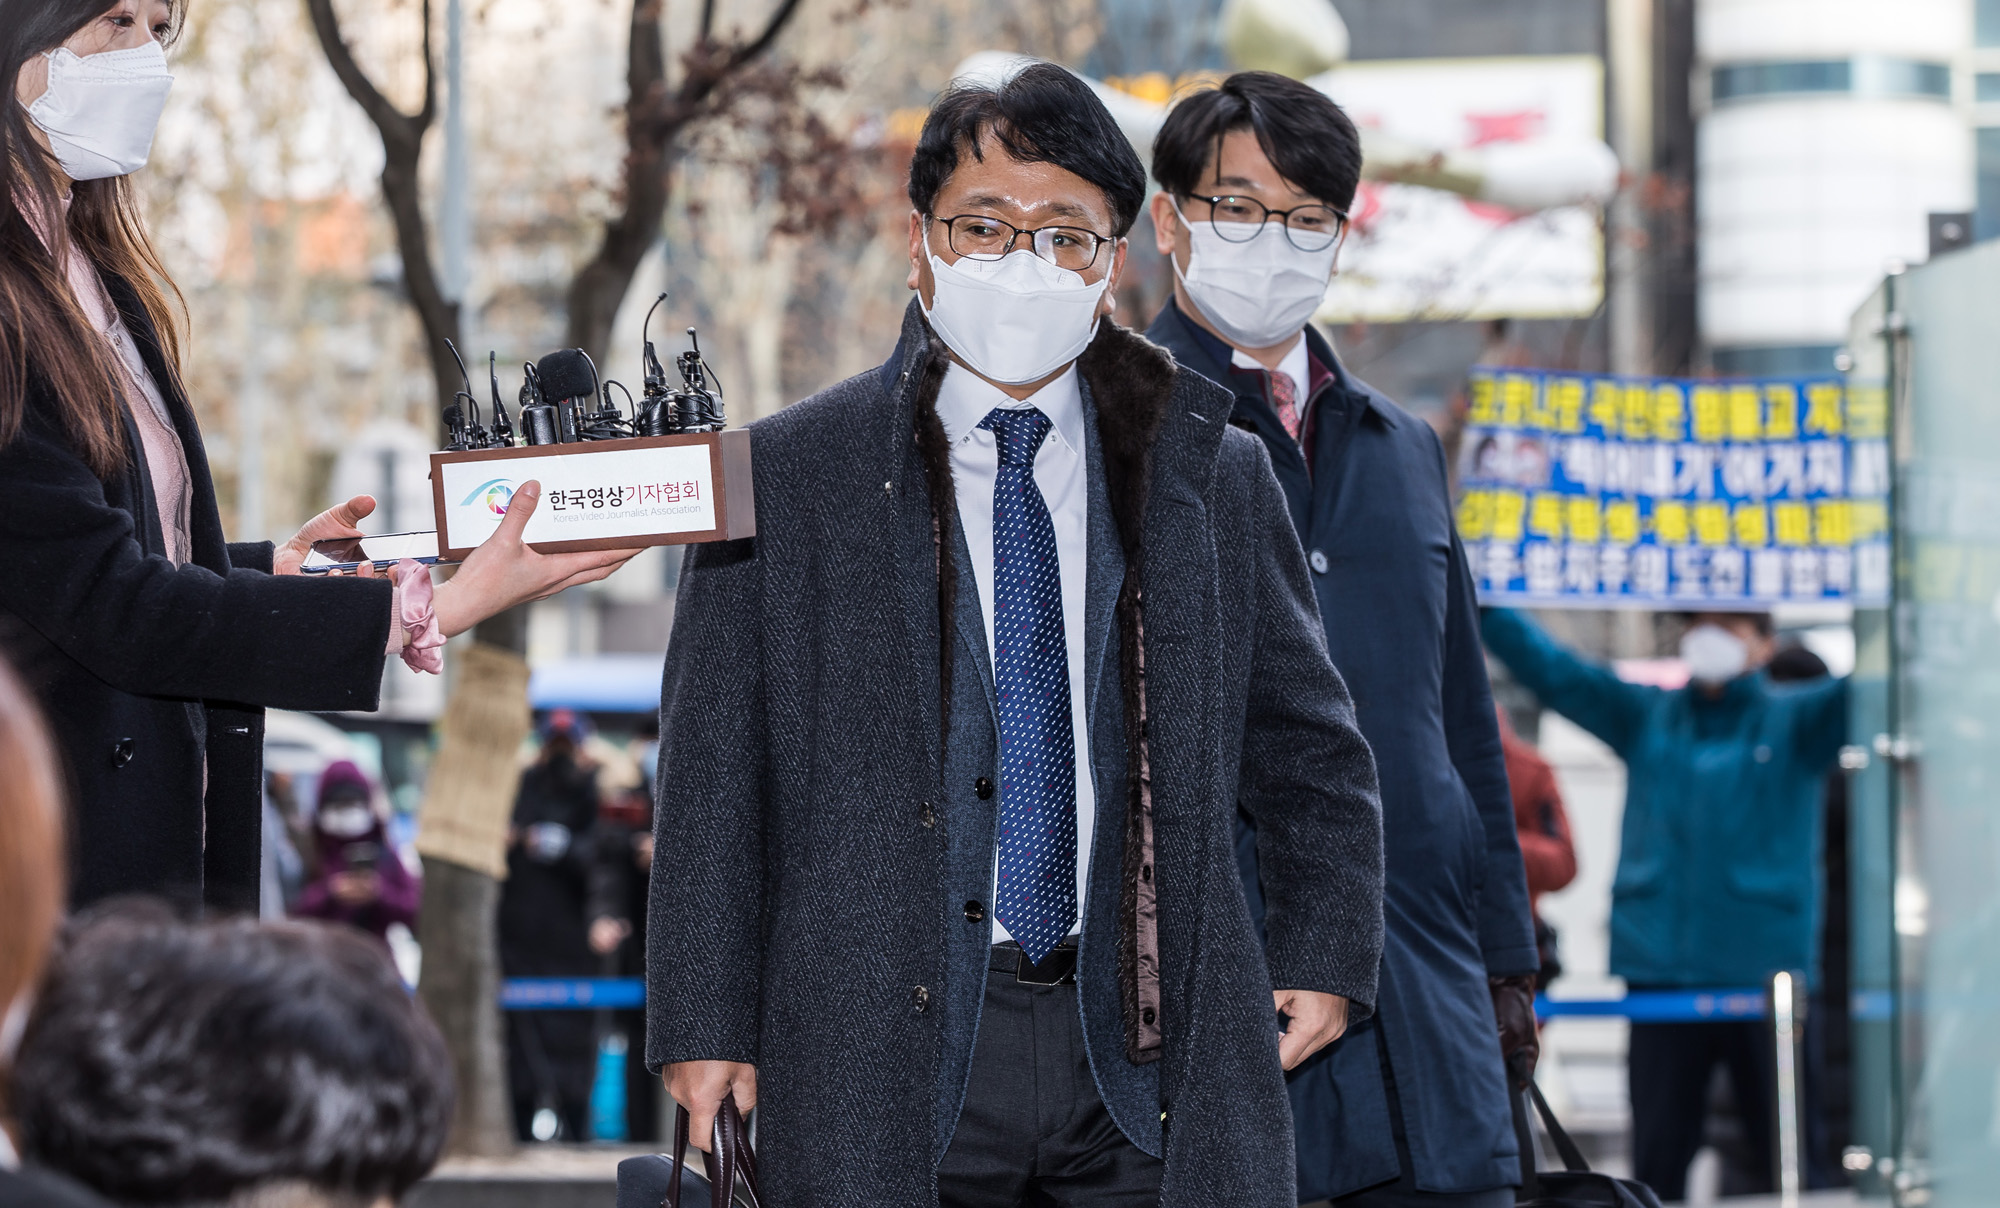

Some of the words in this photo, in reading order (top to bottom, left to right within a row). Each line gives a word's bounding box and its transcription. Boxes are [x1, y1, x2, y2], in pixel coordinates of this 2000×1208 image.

[549, 480, 700, 511] 한국영상기자협회
[553, 514, 579, 523] Korea
[580, 511, 605, 521] Video
[606, 508, 648, 520] Journalist
[650, 505, 701, 515] Association
